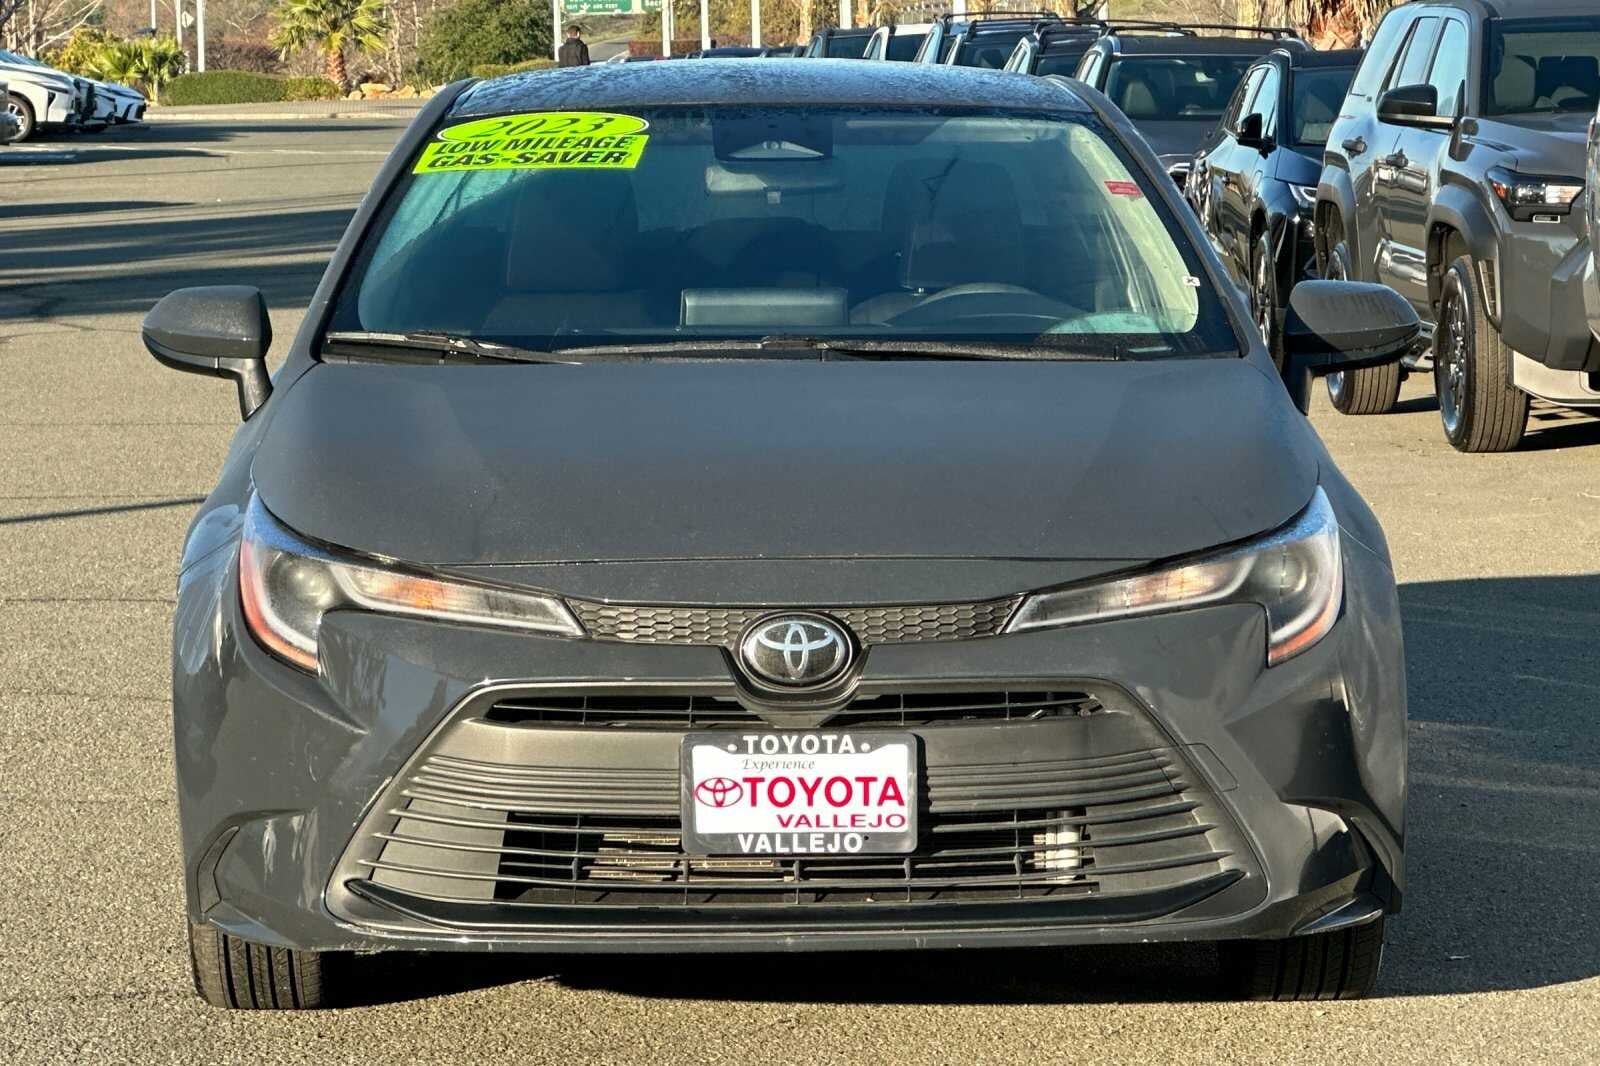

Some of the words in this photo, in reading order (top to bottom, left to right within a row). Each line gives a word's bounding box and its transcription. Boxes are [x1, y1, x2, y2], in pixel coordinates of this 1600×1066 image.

[468, 117, 615, 139] 2023
[433, 139, 502, 155] LOW
[502, 136, 634, 151] MILEAGE
[426, 151, 631, 167] GAS-SAVER
[742, 734, 856, 754] TOYOTA
[742, 758, 816, 772] Experience
[742, 776, 905, 808] TOYOTA
[776, 813, 906, 828] VALLEJO
[737, 832, 863, 853] VALLEJO
